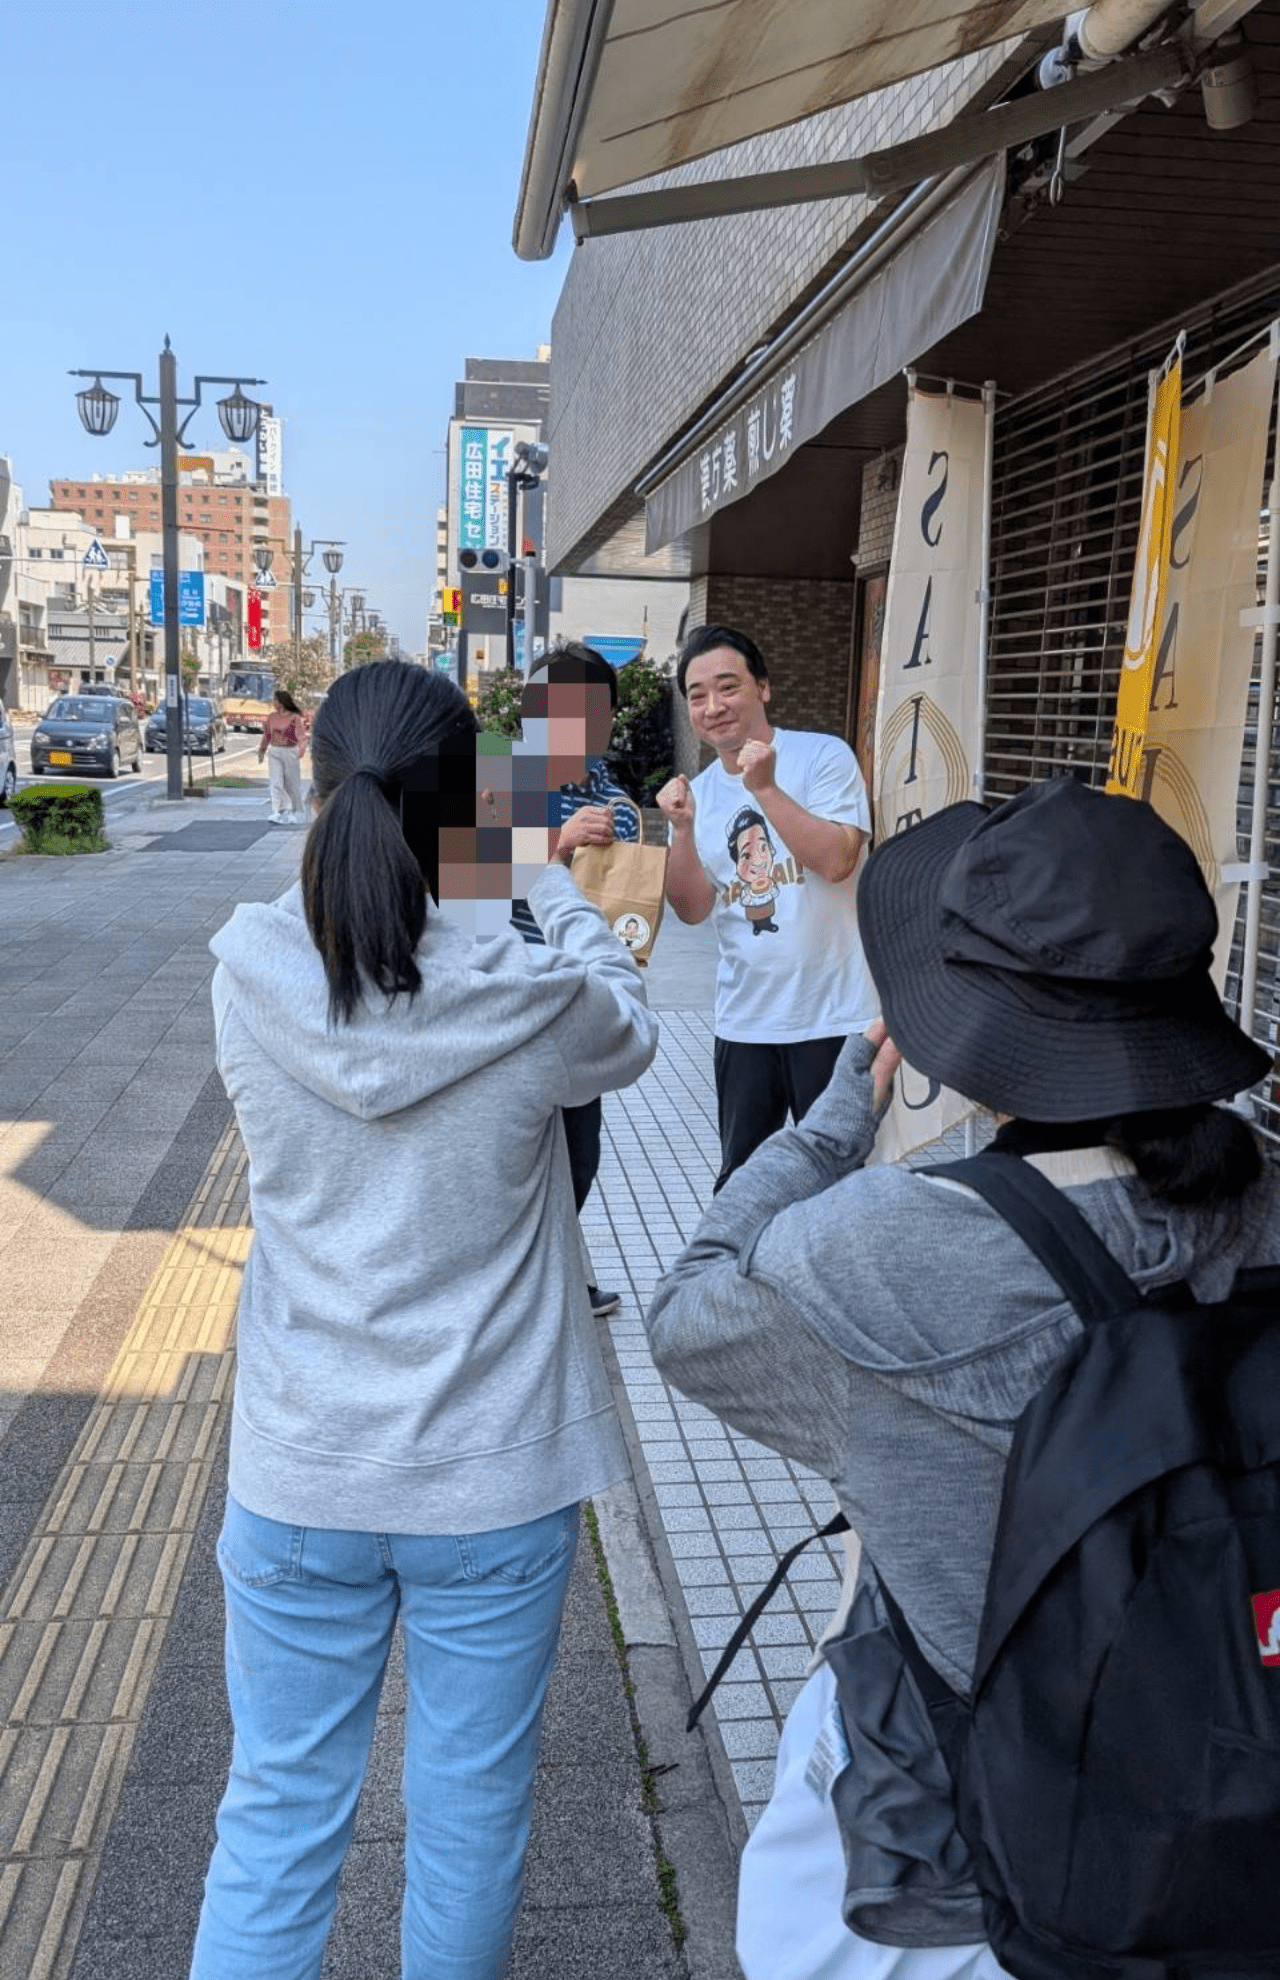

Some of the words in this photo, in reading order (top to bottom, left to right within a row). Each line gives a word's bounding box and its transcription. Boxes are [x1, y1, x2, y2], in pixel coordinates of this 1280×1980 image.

[464, 441, 483, 548] 広田住宅セ
